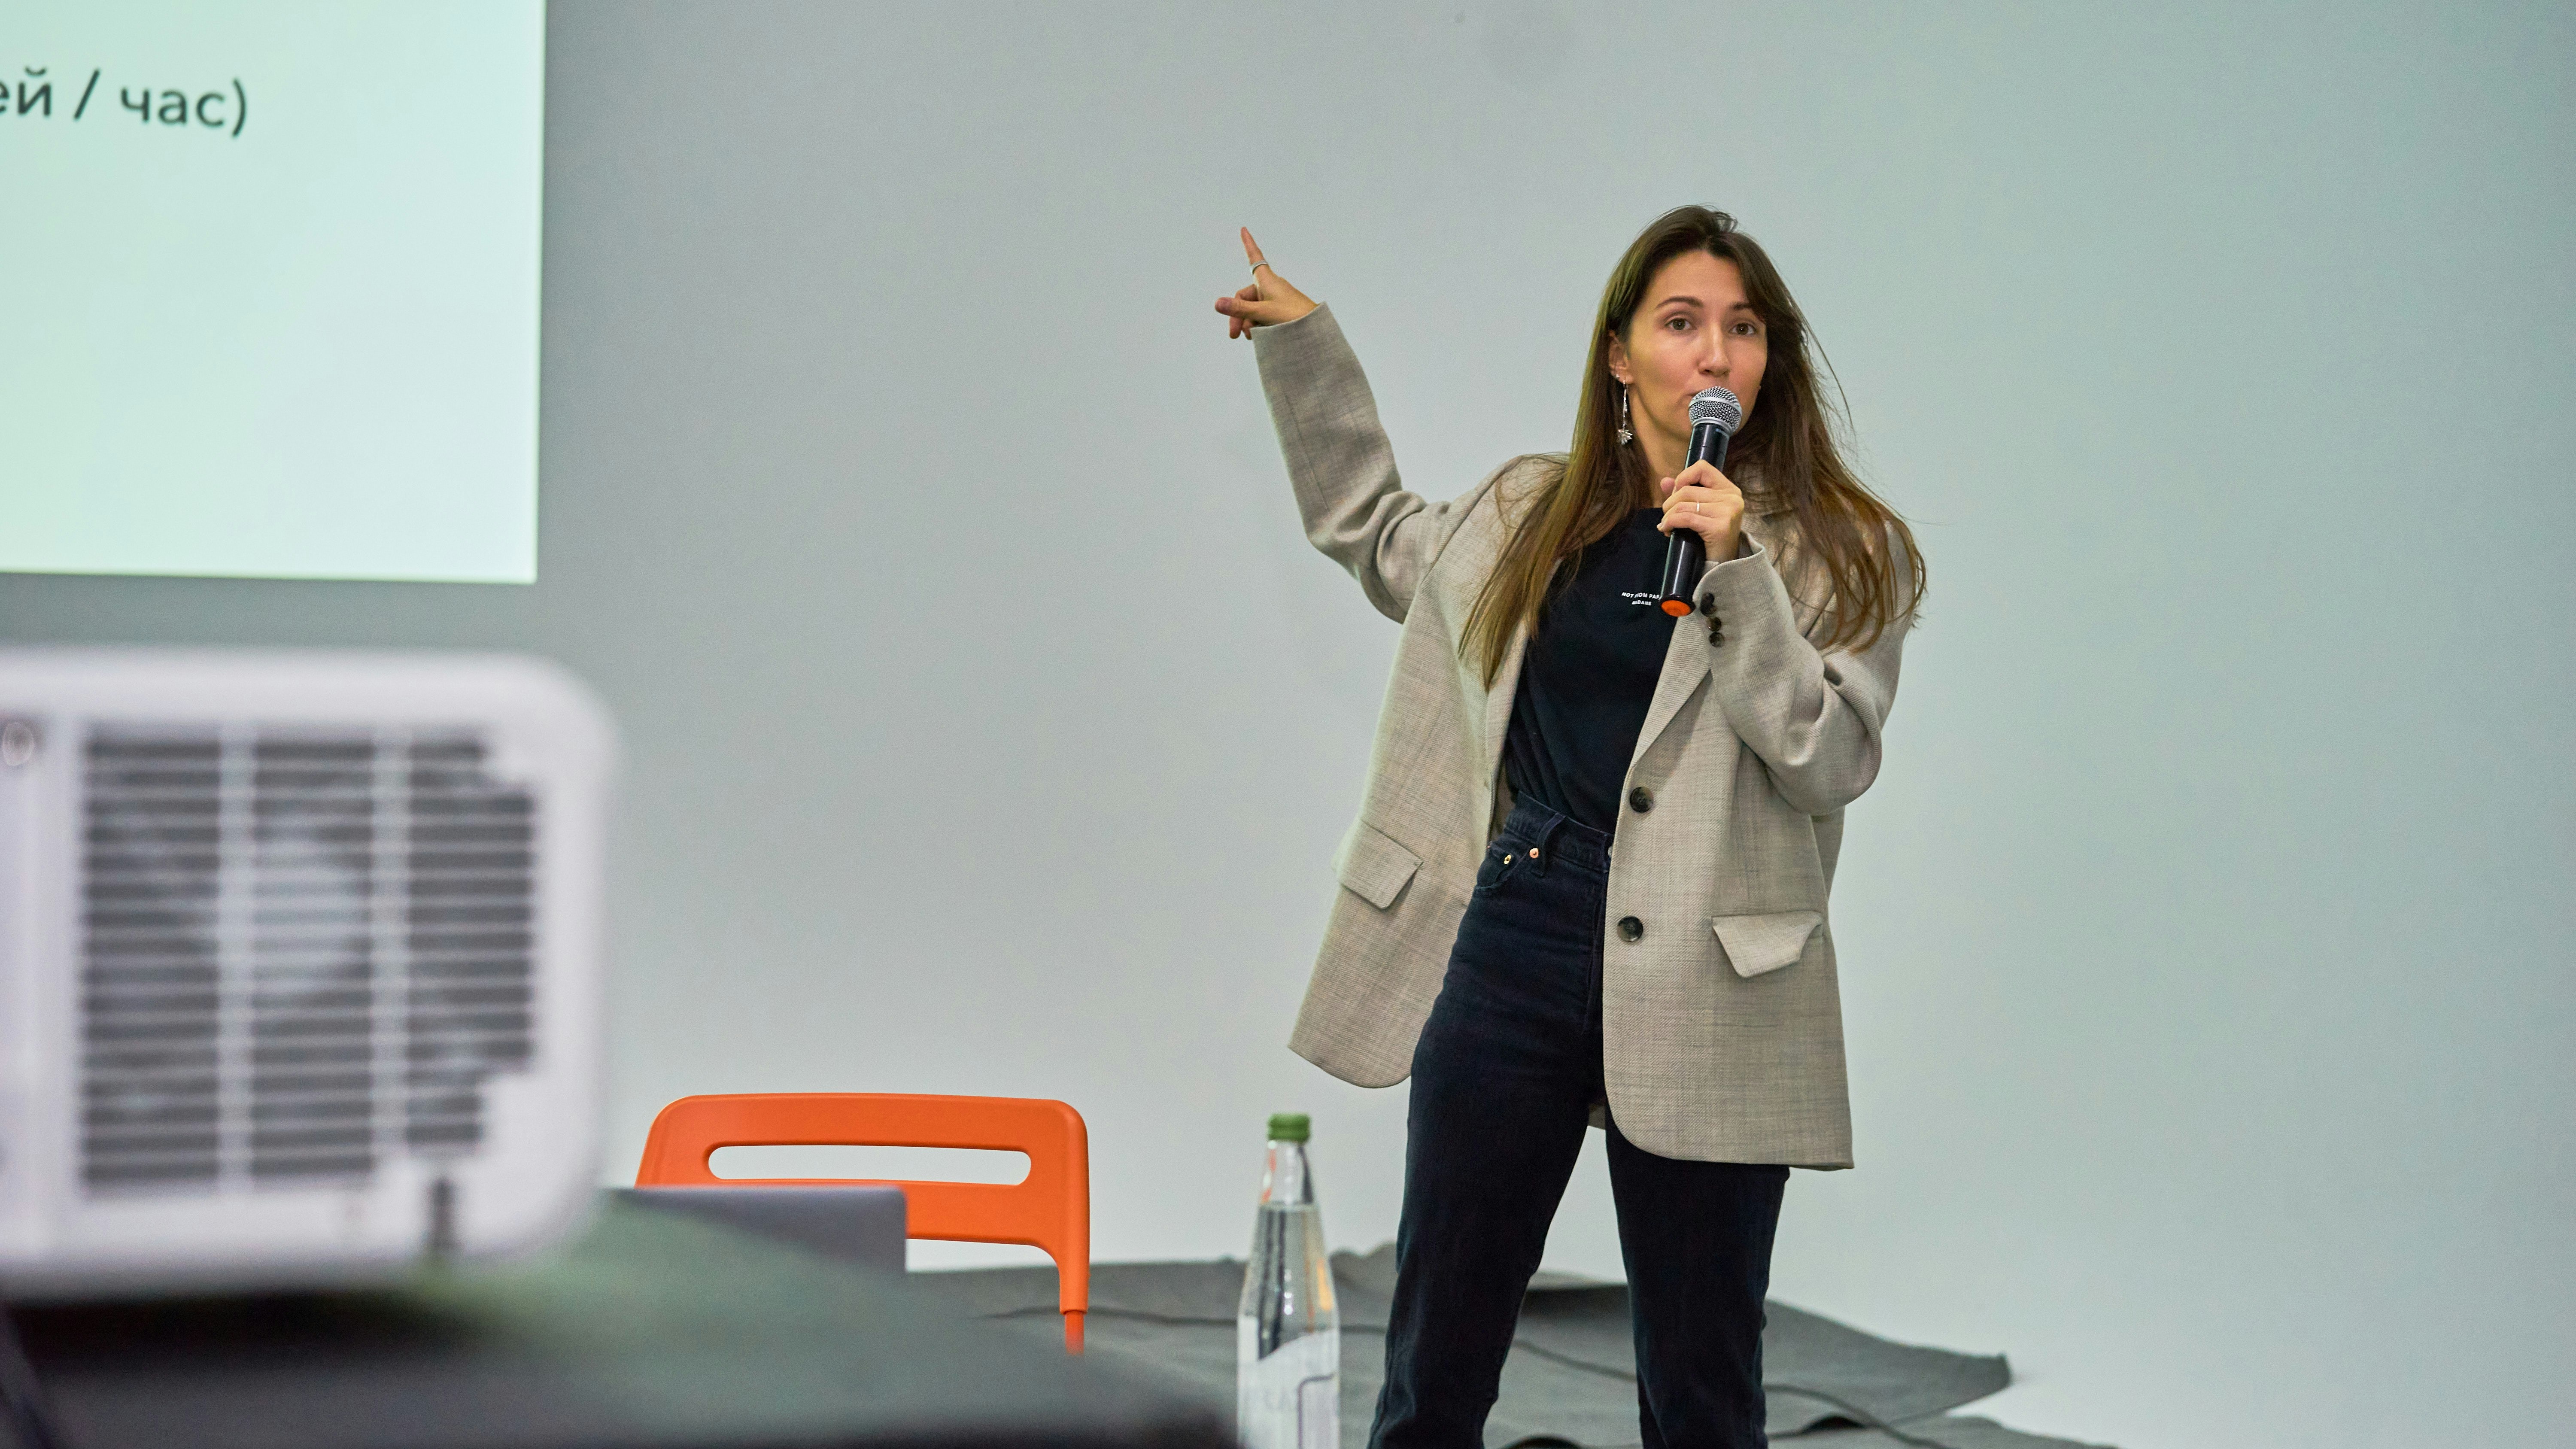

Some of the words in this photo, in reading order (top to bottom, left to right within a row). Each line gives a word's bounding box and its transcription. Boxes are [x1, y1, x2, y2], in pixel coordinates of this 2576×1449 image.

[0, 67, 52, 118] й
[74, 69, 100, 120] /
[120, 78, 246, 138] час)
